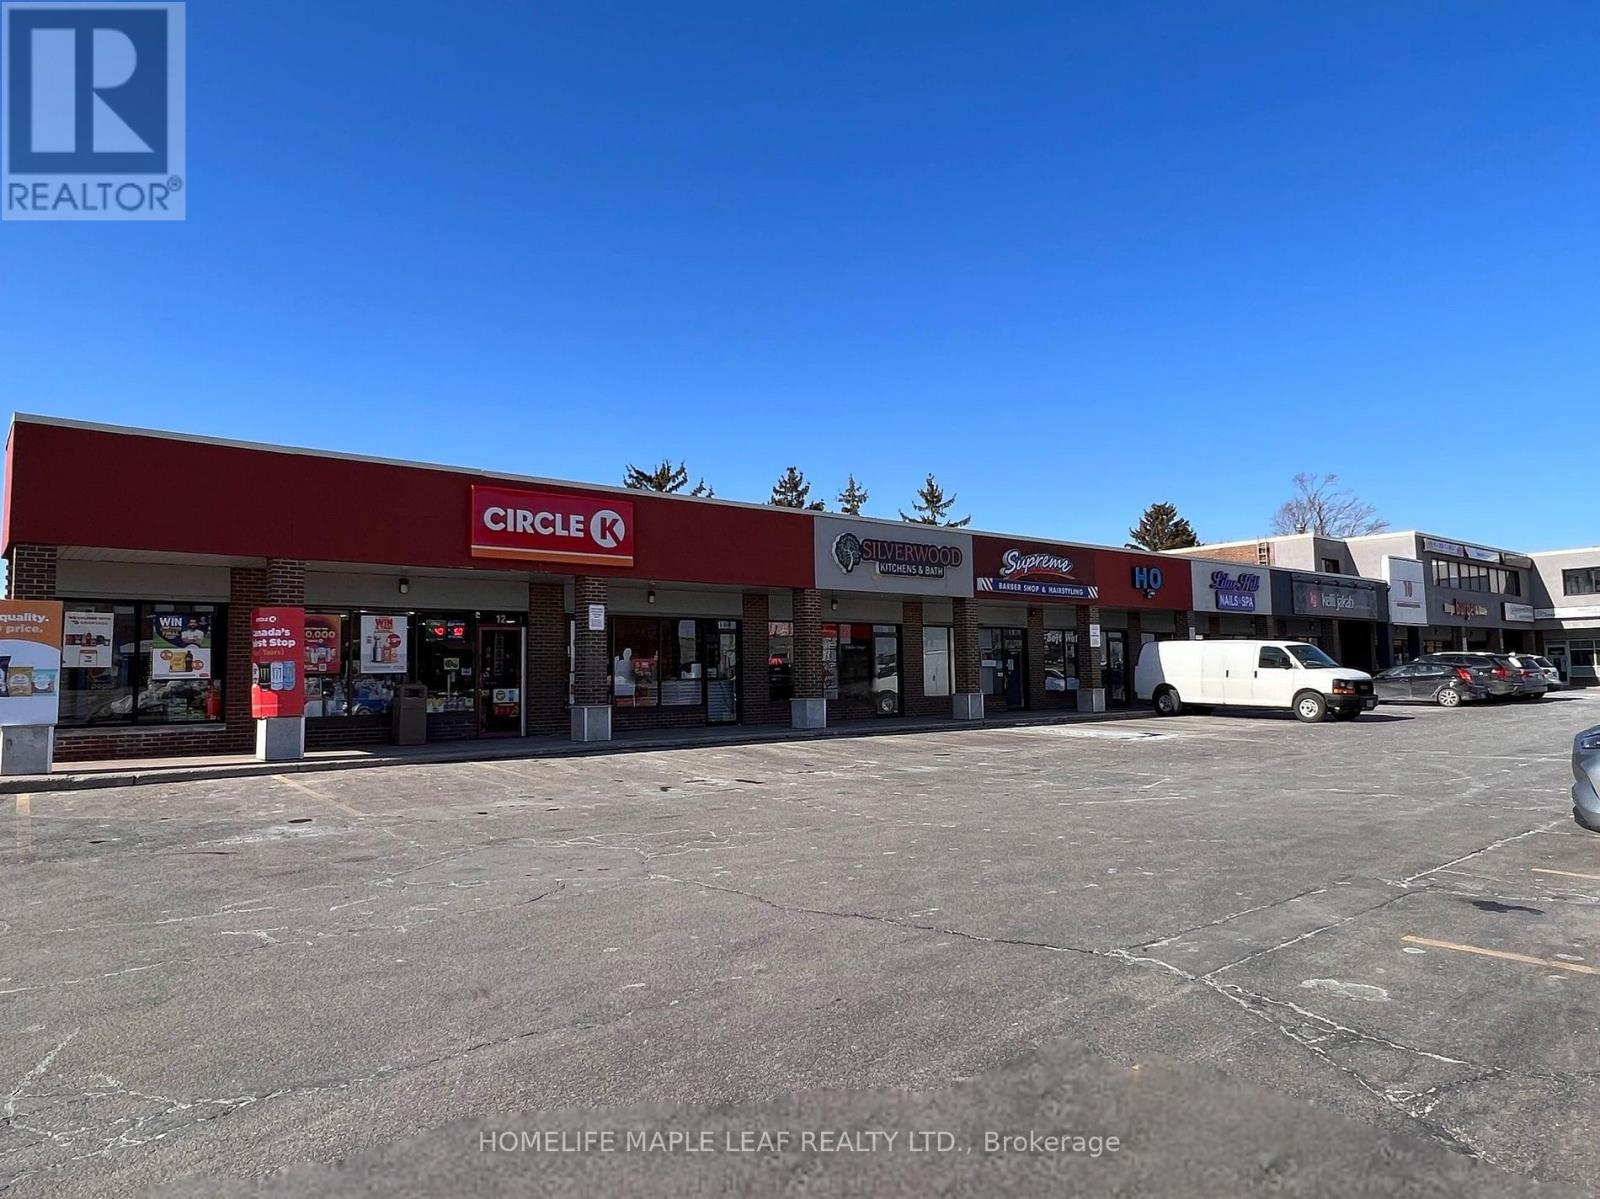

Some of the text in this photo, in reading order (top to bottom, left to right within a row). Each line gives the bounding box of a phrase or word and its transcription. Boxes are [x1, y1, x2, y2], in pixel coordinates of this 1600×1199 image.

[483, 506, 623, 546] CIRCLE K
[862, 541, 962, 565] SILVERWOOD
[1003, 549, 1073, 574] Supreme
[880, 562, 944, 576] KITCHENS & BATH
[998, 582, 1022, 591] BARBER
[1023, 584, 1040, 593] SHOP
[1048, 587, 1084, 596] HAIRSTYLING
[1219, 594, 1255, 607] NAILS SPA
[0, 612, 50, 624] quality.
[159, 617, 183, 627] WIN
[496, 614, 506, 624] 12
[5, 623, 44, 634] price.
[269, 638, 297, 648] Stop
